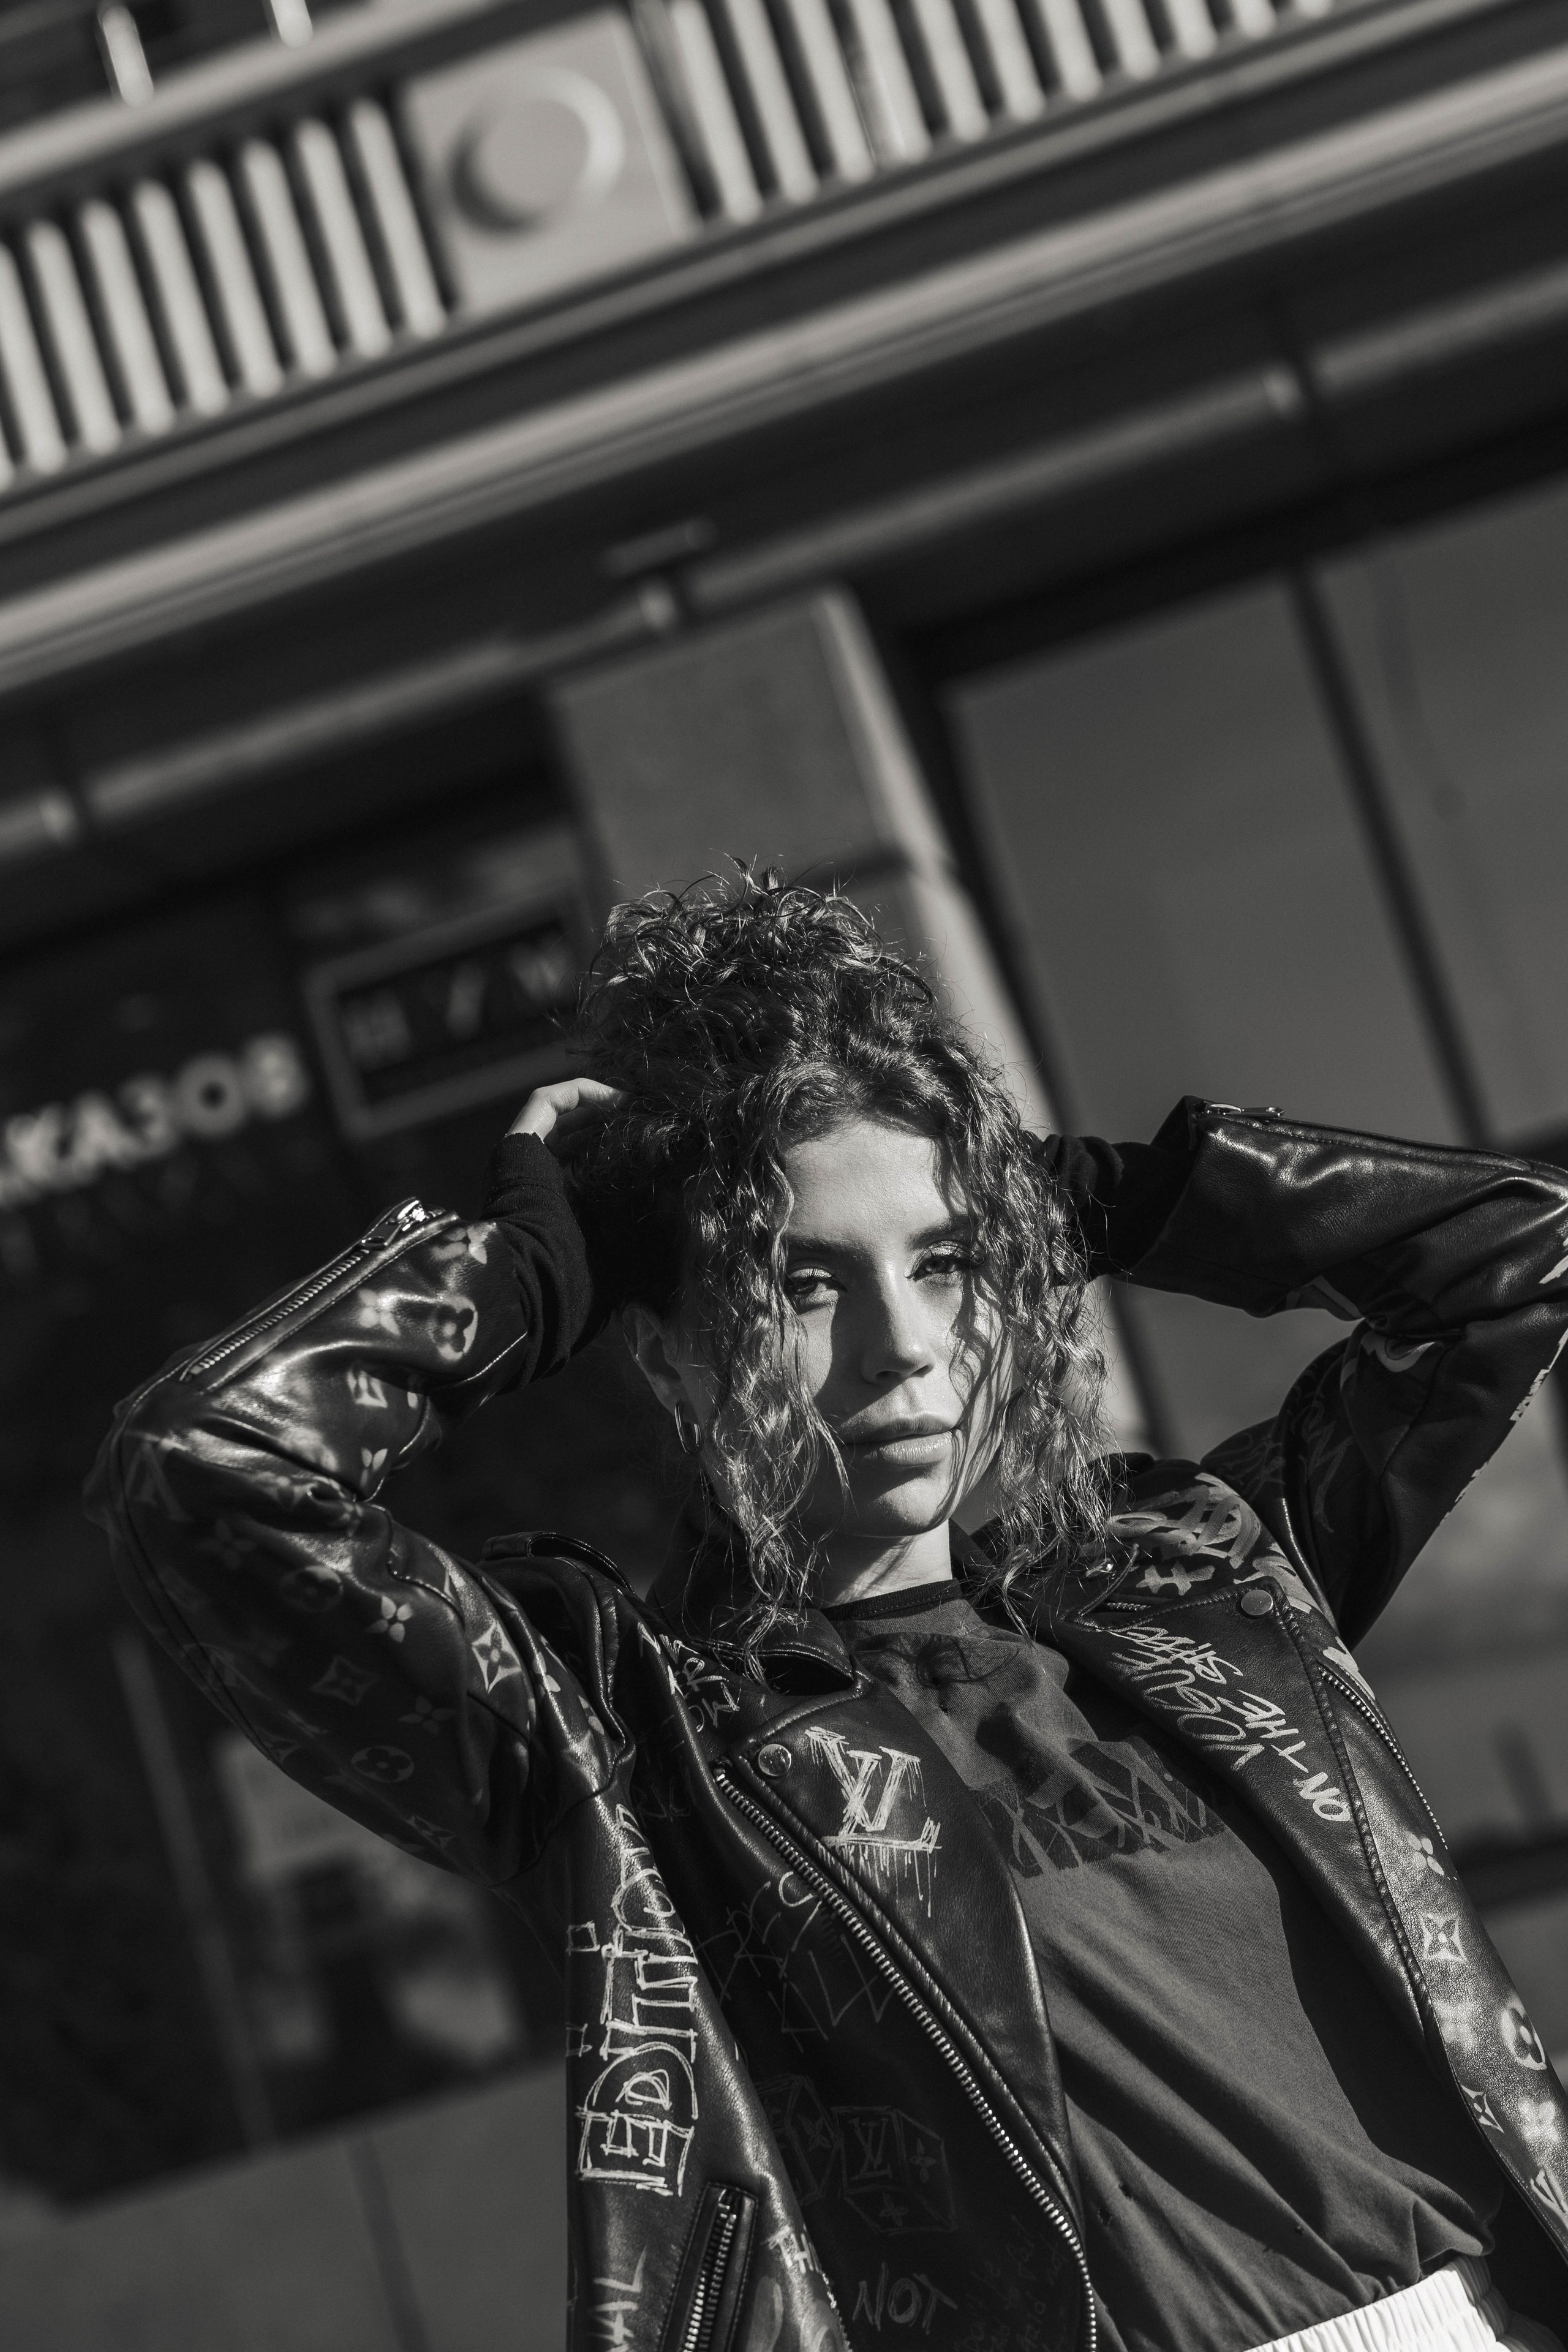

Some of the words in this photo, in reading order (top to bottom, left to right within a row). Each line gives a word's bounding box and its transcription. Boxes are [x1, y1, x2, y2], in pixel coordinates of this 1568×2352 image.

[0, 1031, 305, 1208] КАЗОВ
[1111, 1650, 1265, 1771] VOGUE
[1216, 1689, 1308, 1772] THE
[1293, 1771, 1351, 1822] ON
[852, 2261, 958, 2334] NOT
